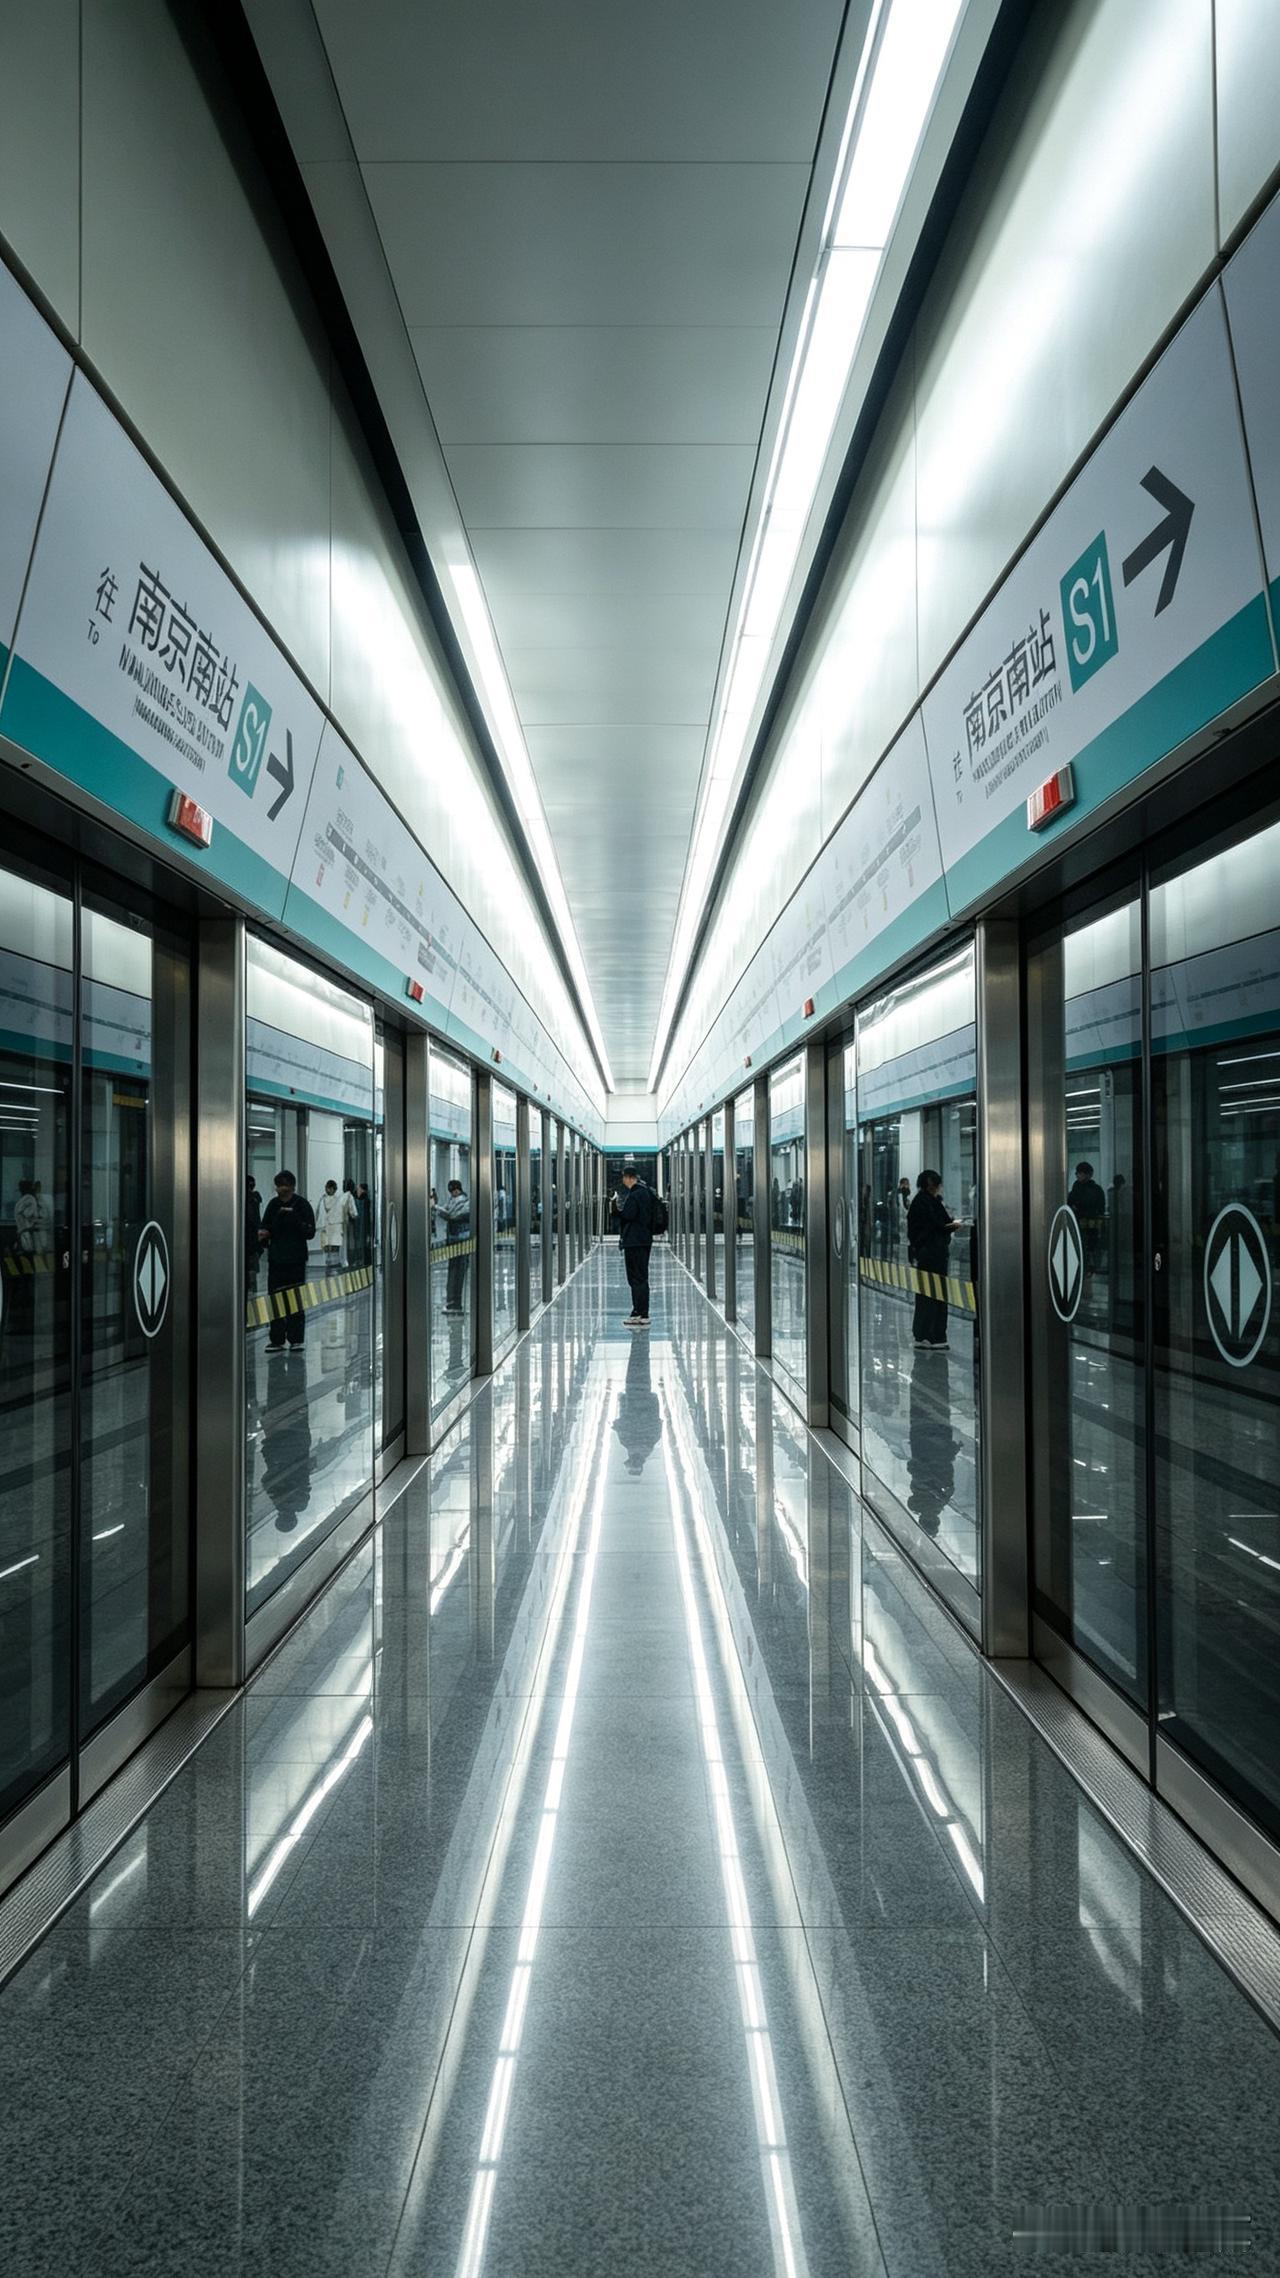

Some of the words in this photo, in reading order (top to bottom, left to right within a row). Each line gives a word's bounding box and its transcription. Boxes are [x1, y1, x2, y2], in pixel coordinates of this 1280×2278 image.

[88, 619, 100, 645] To
[95, 567, 119, 623] 往
[128, 561, 238, 732] 南京南站
[236, 702, 266, 781] S1
[963, 608, 1057, 767] 南京南站
[1069, 557, 1111, 666] S1
